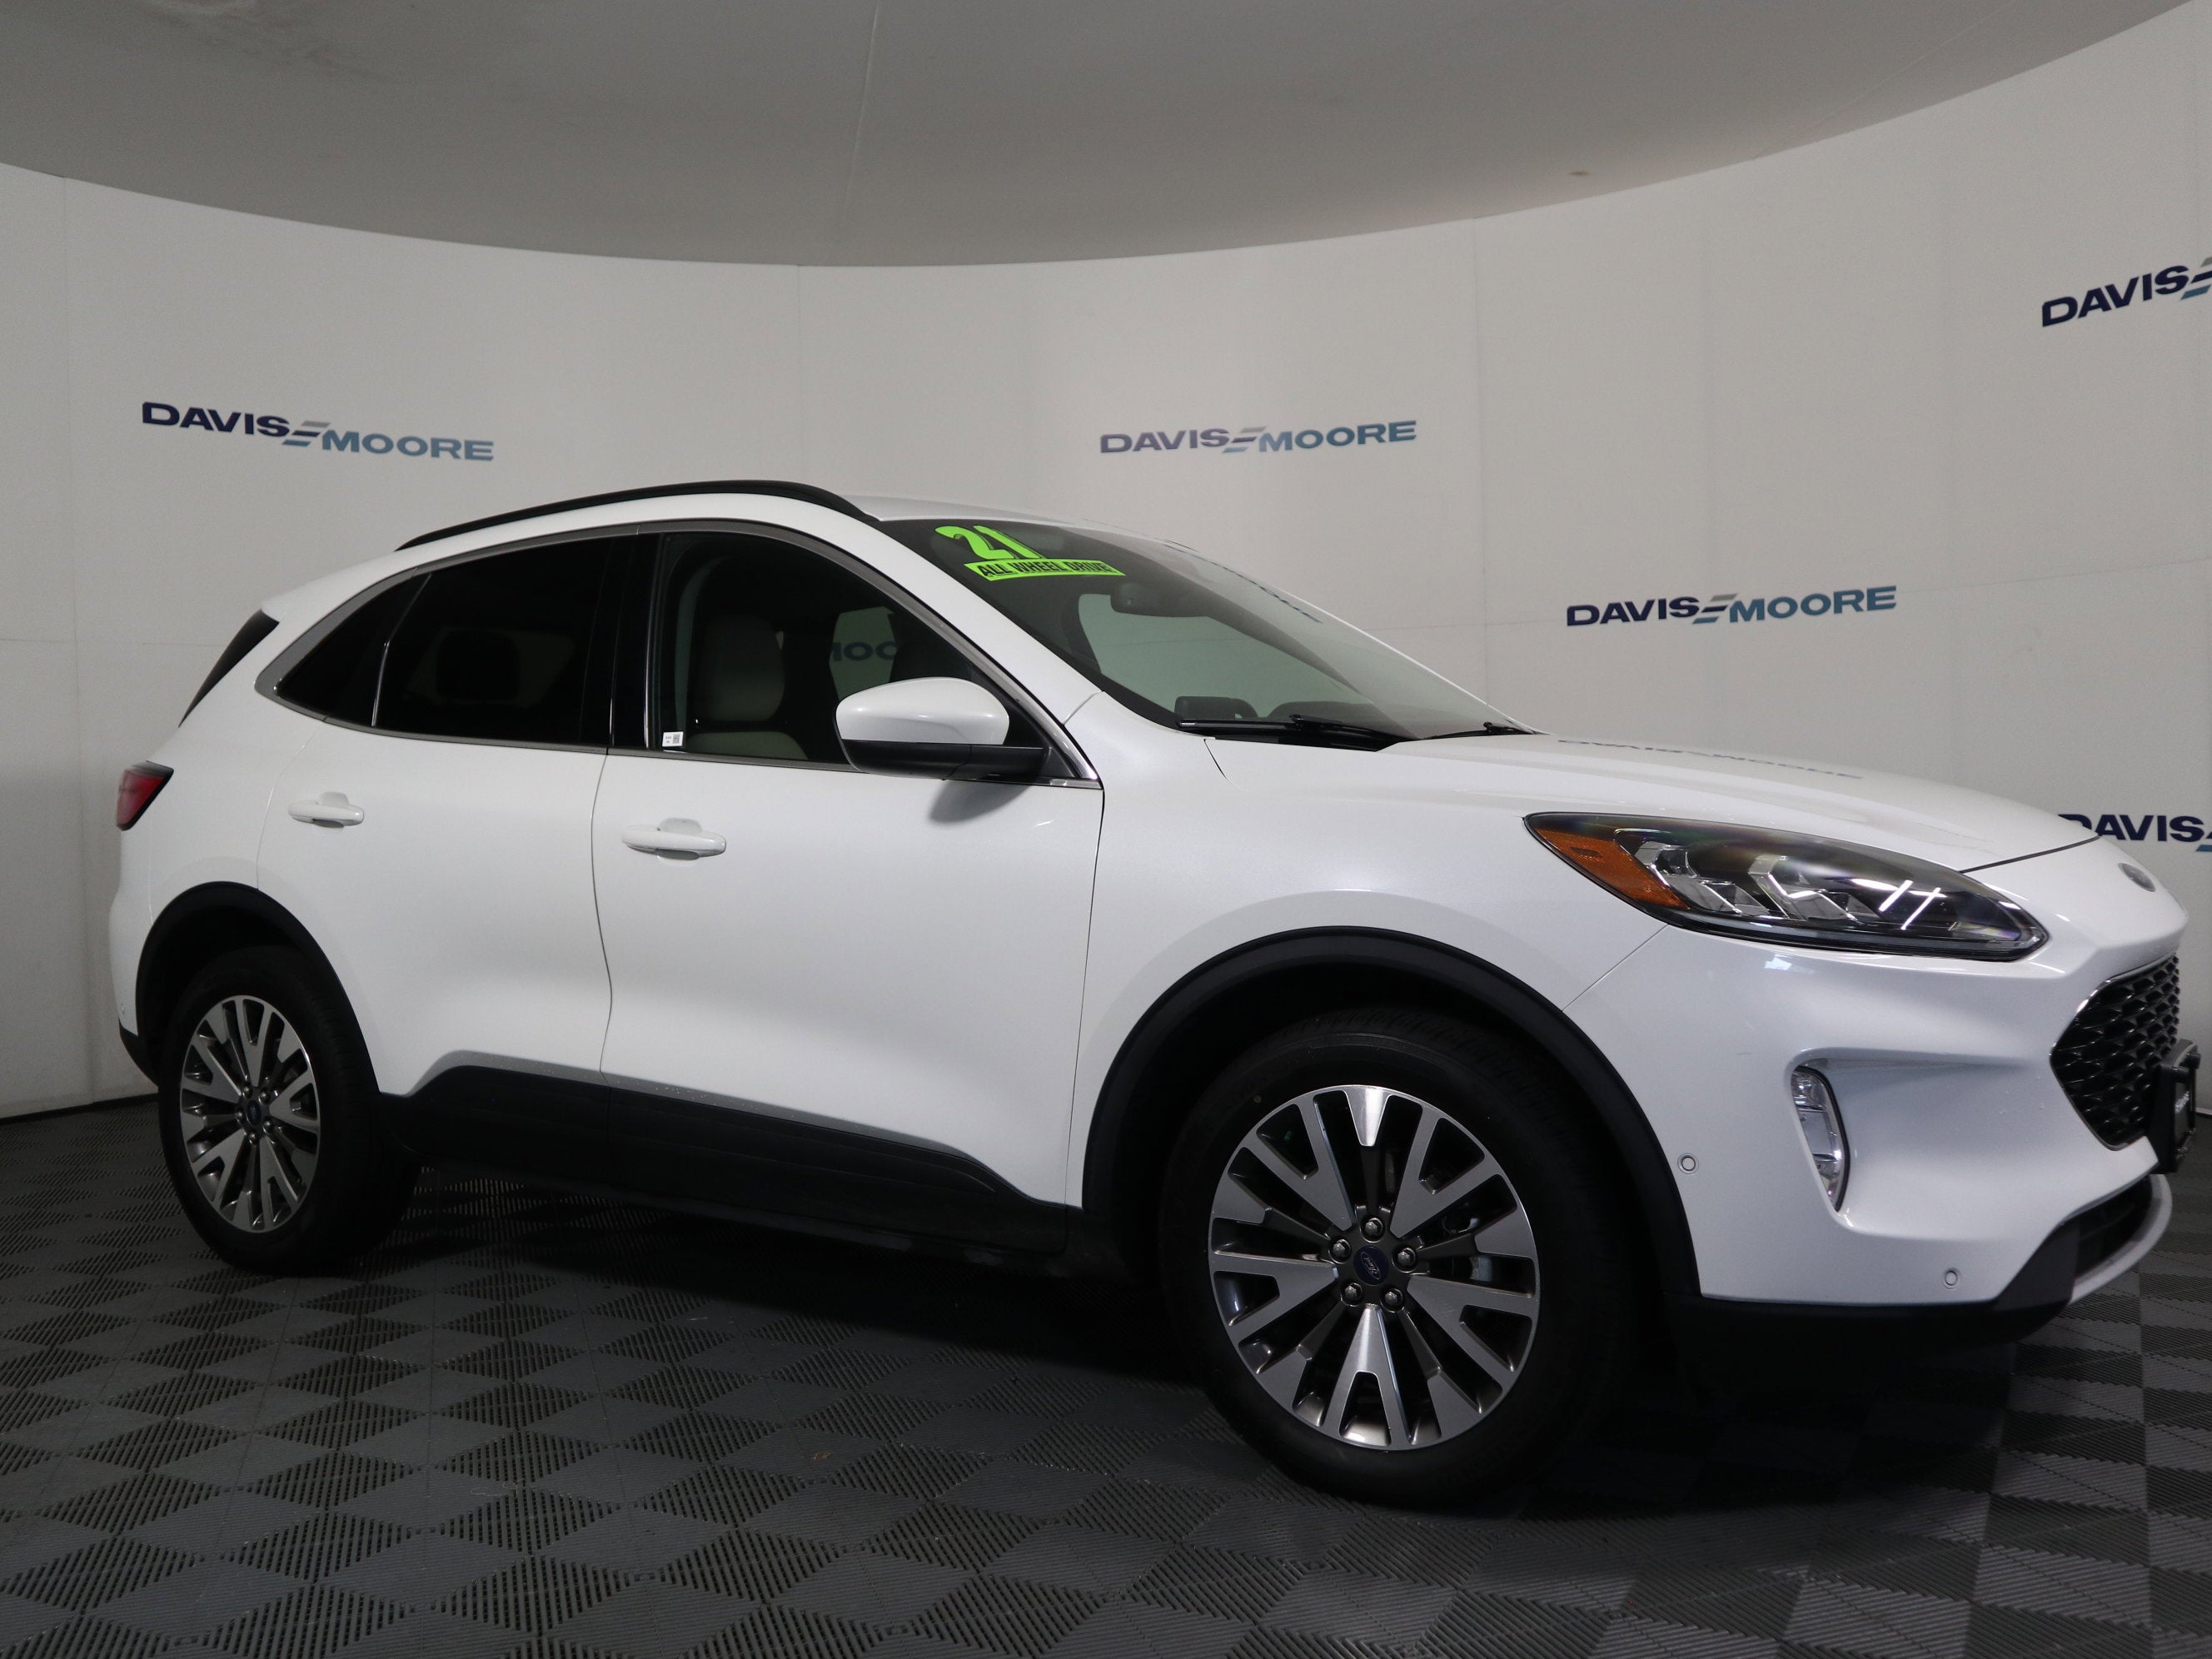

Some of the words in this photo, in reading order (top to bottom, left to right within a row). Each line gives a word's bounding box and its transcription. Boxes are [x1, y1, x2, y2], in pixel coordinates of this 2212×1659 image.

[2042, 266, 2190, 327] DAVIS
[142, 401, 290, 438] DAVIS
[322, 429, 494, 461] MOORE
[1100, 427, 1230, 454] DAVIS
[1259, 420, 1417, 452] MOORE
[935, 525, 1042, 560] 21
[977, 563, 1014, 576] ALL
[1008, 561, 1069, 572] WHEEL
[1063, 561, 1113, 572] DRIVE
[1567, 595, 1700, 627] DAVIS
[1729, 585, 1897, 624] MOORE
